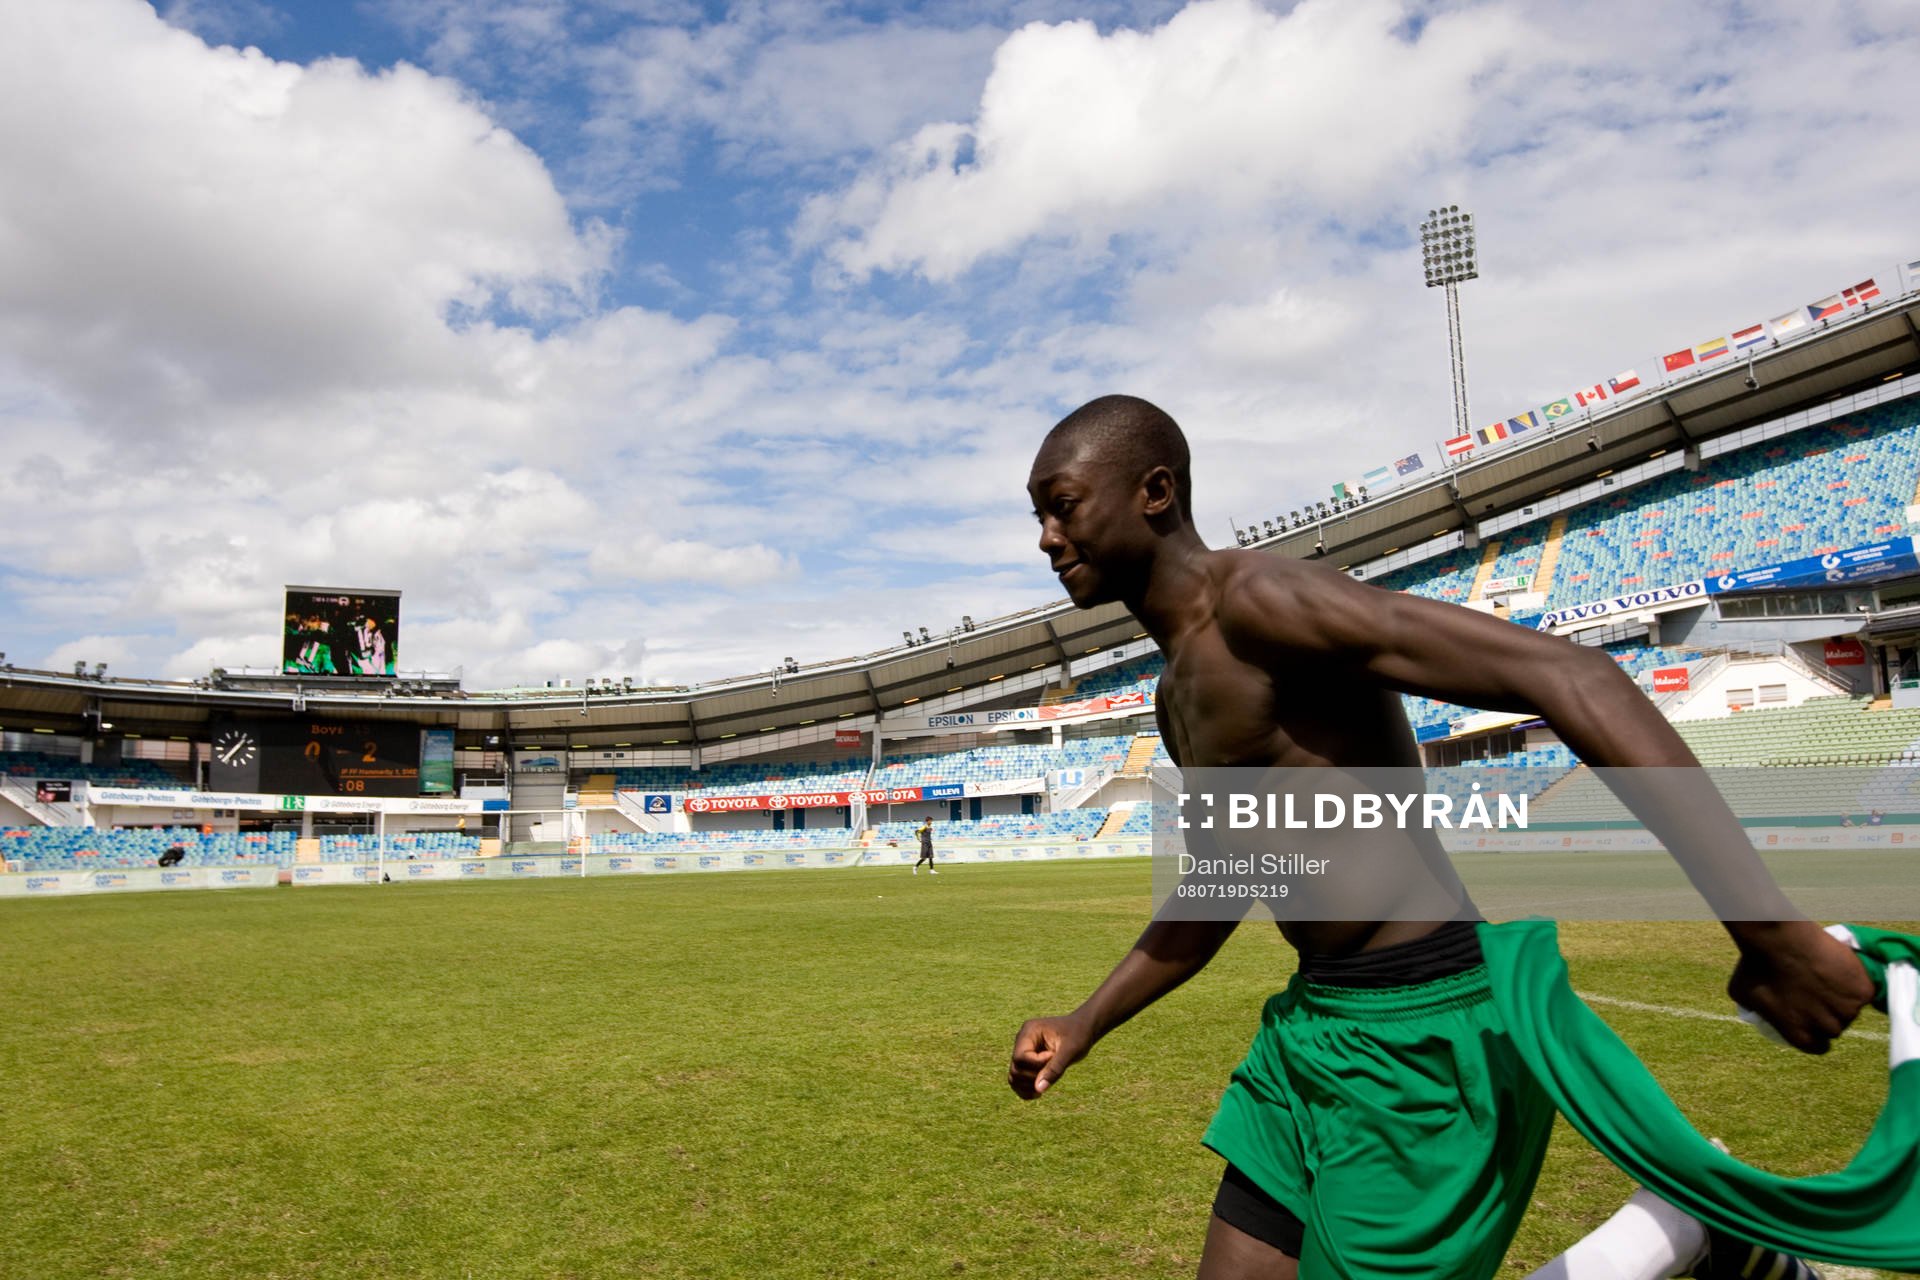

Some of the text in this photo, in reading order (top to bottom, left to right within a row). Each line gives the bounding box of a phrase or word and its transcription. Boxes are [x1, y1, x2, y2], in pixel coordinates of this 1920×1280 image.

[1613, 583, 1701, 609] VOLVO
[928, 714, 974, 727] EPSILON
[988, 710, 1034, 723] EPSILON
[362, 741, 377, 762] 2
[932, 788, 960, 796] ULLEVI
[711, 798, 760, 809] TOYOTA
[789, 795, 838, 806] TOYOTA
